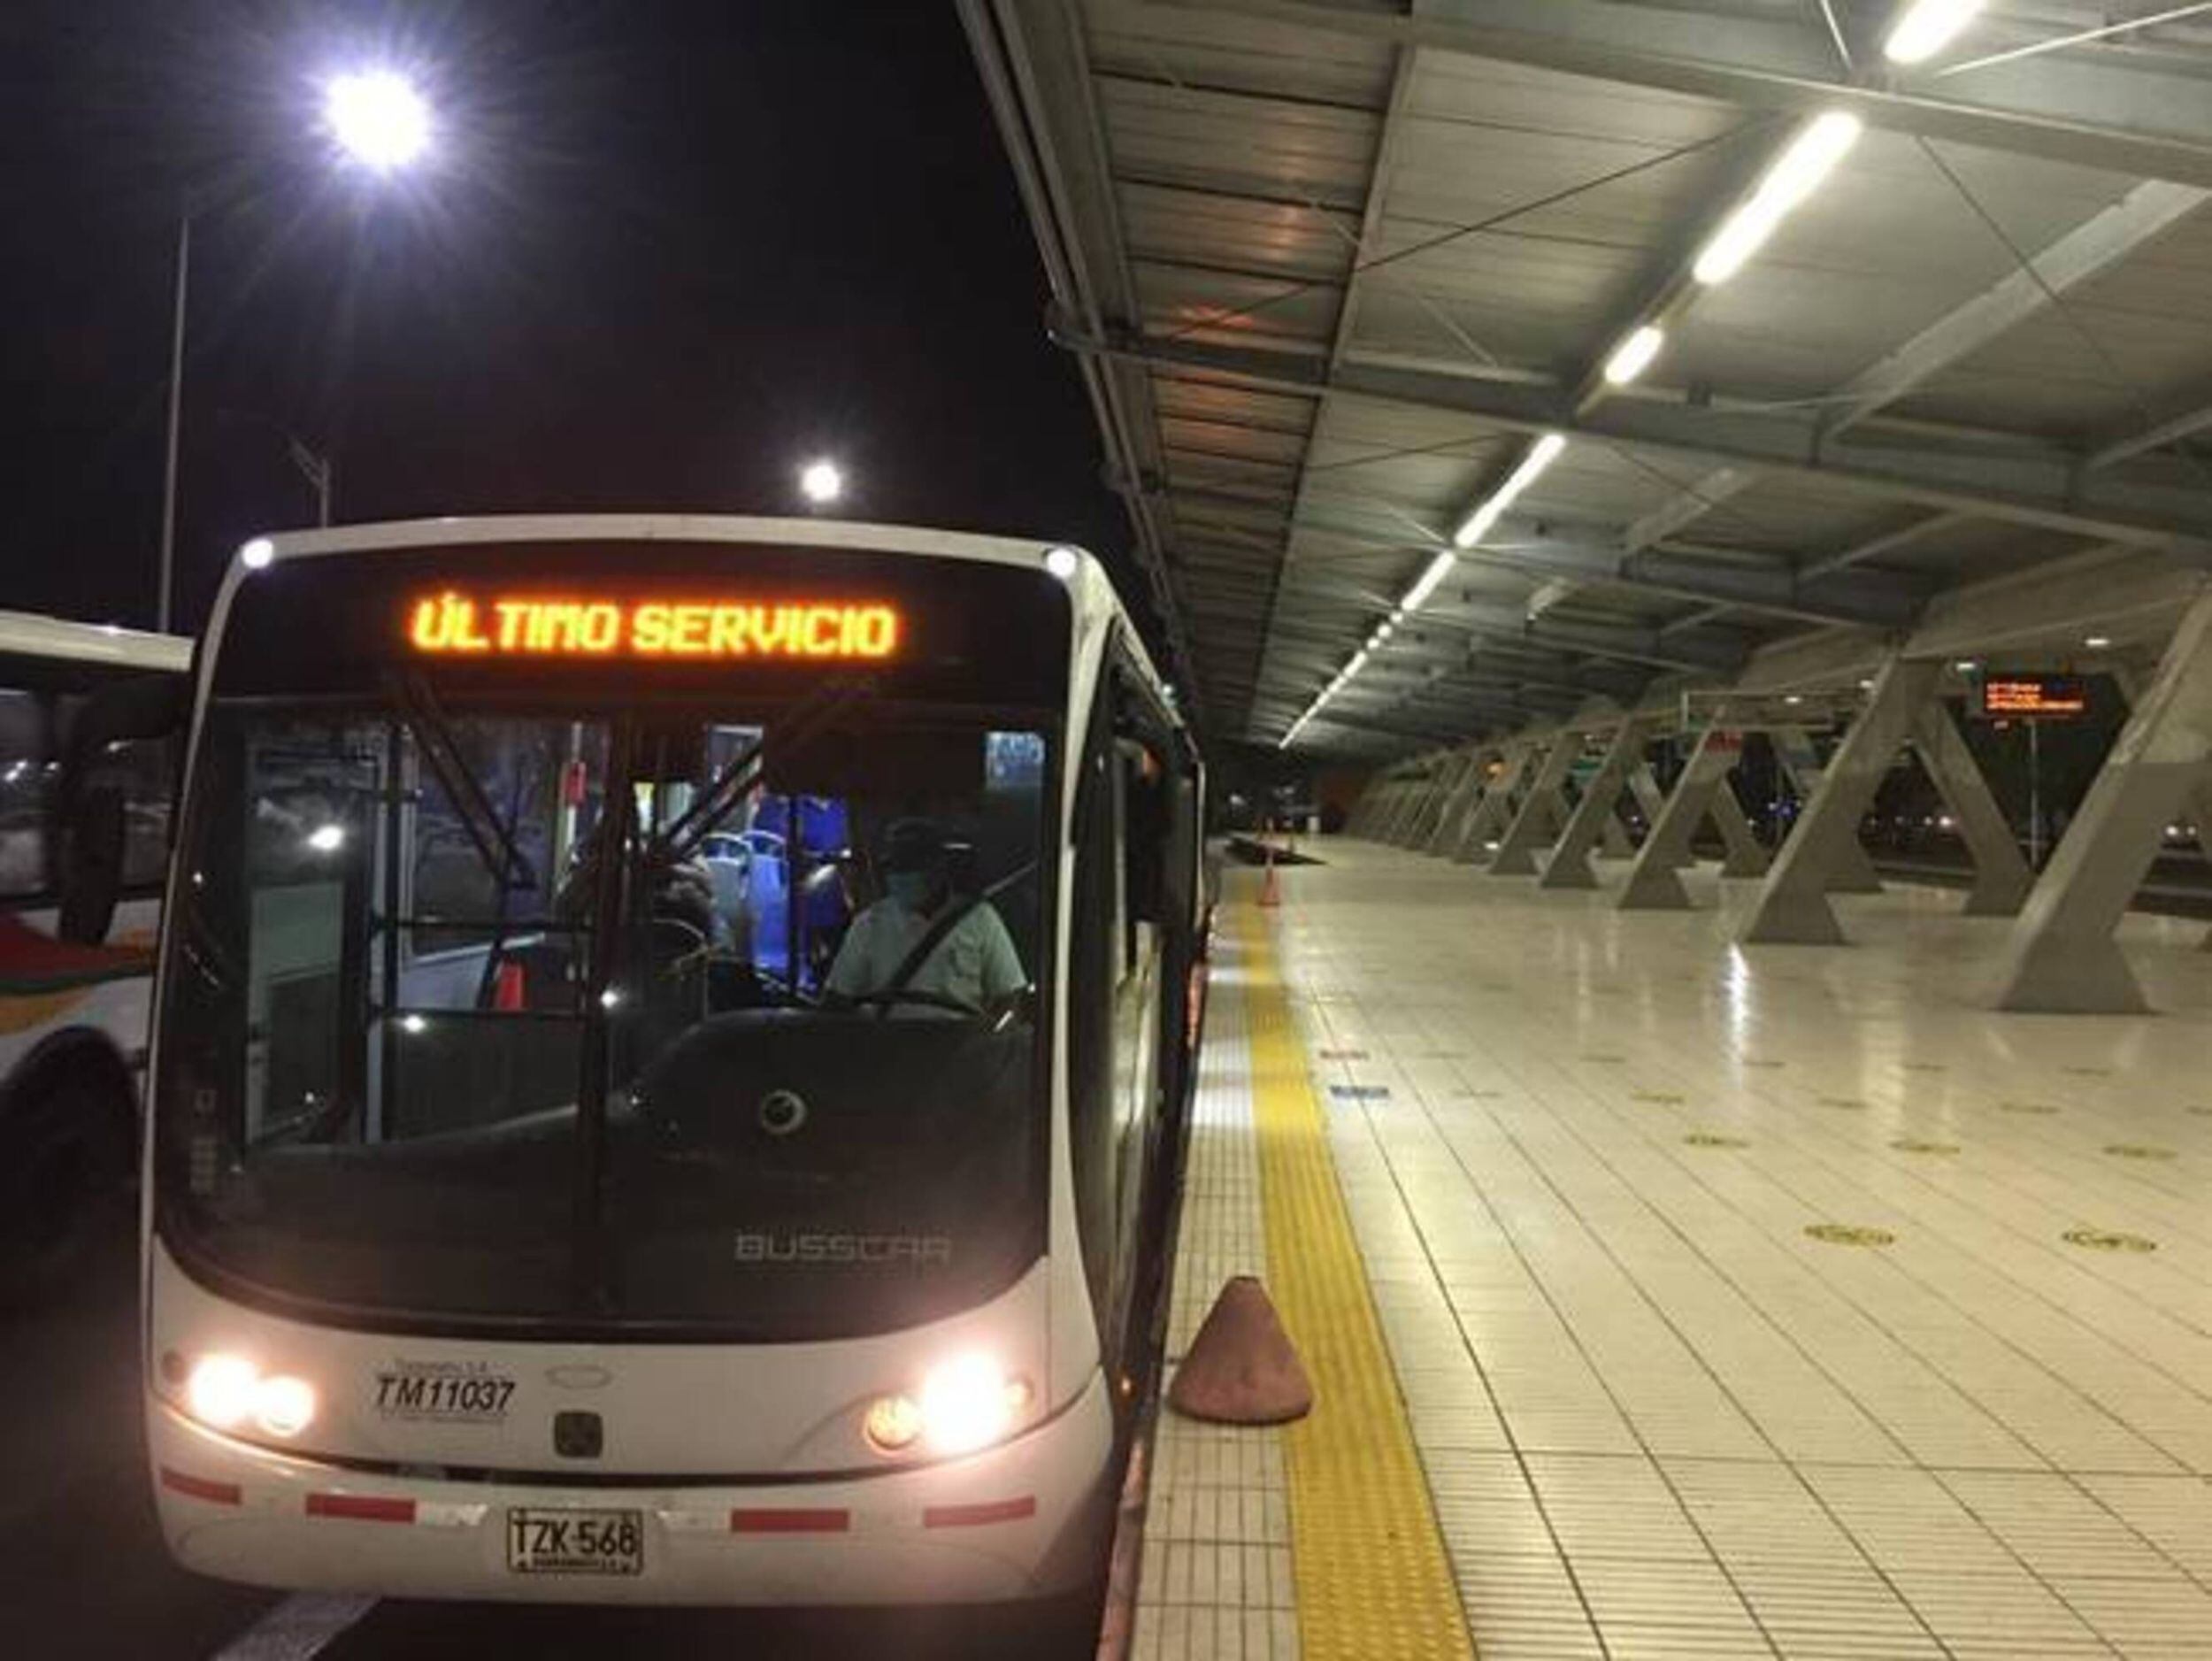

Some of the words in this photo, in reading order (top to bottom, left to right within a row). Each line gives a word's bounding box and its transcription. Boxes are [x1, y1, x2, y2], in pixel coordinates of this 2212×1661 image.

[631, 603, 896, 656] SERVICIO
[734, 1234, 952, 1265] BUSSCAR
[376, 1375, 517, 1412] TM11037
